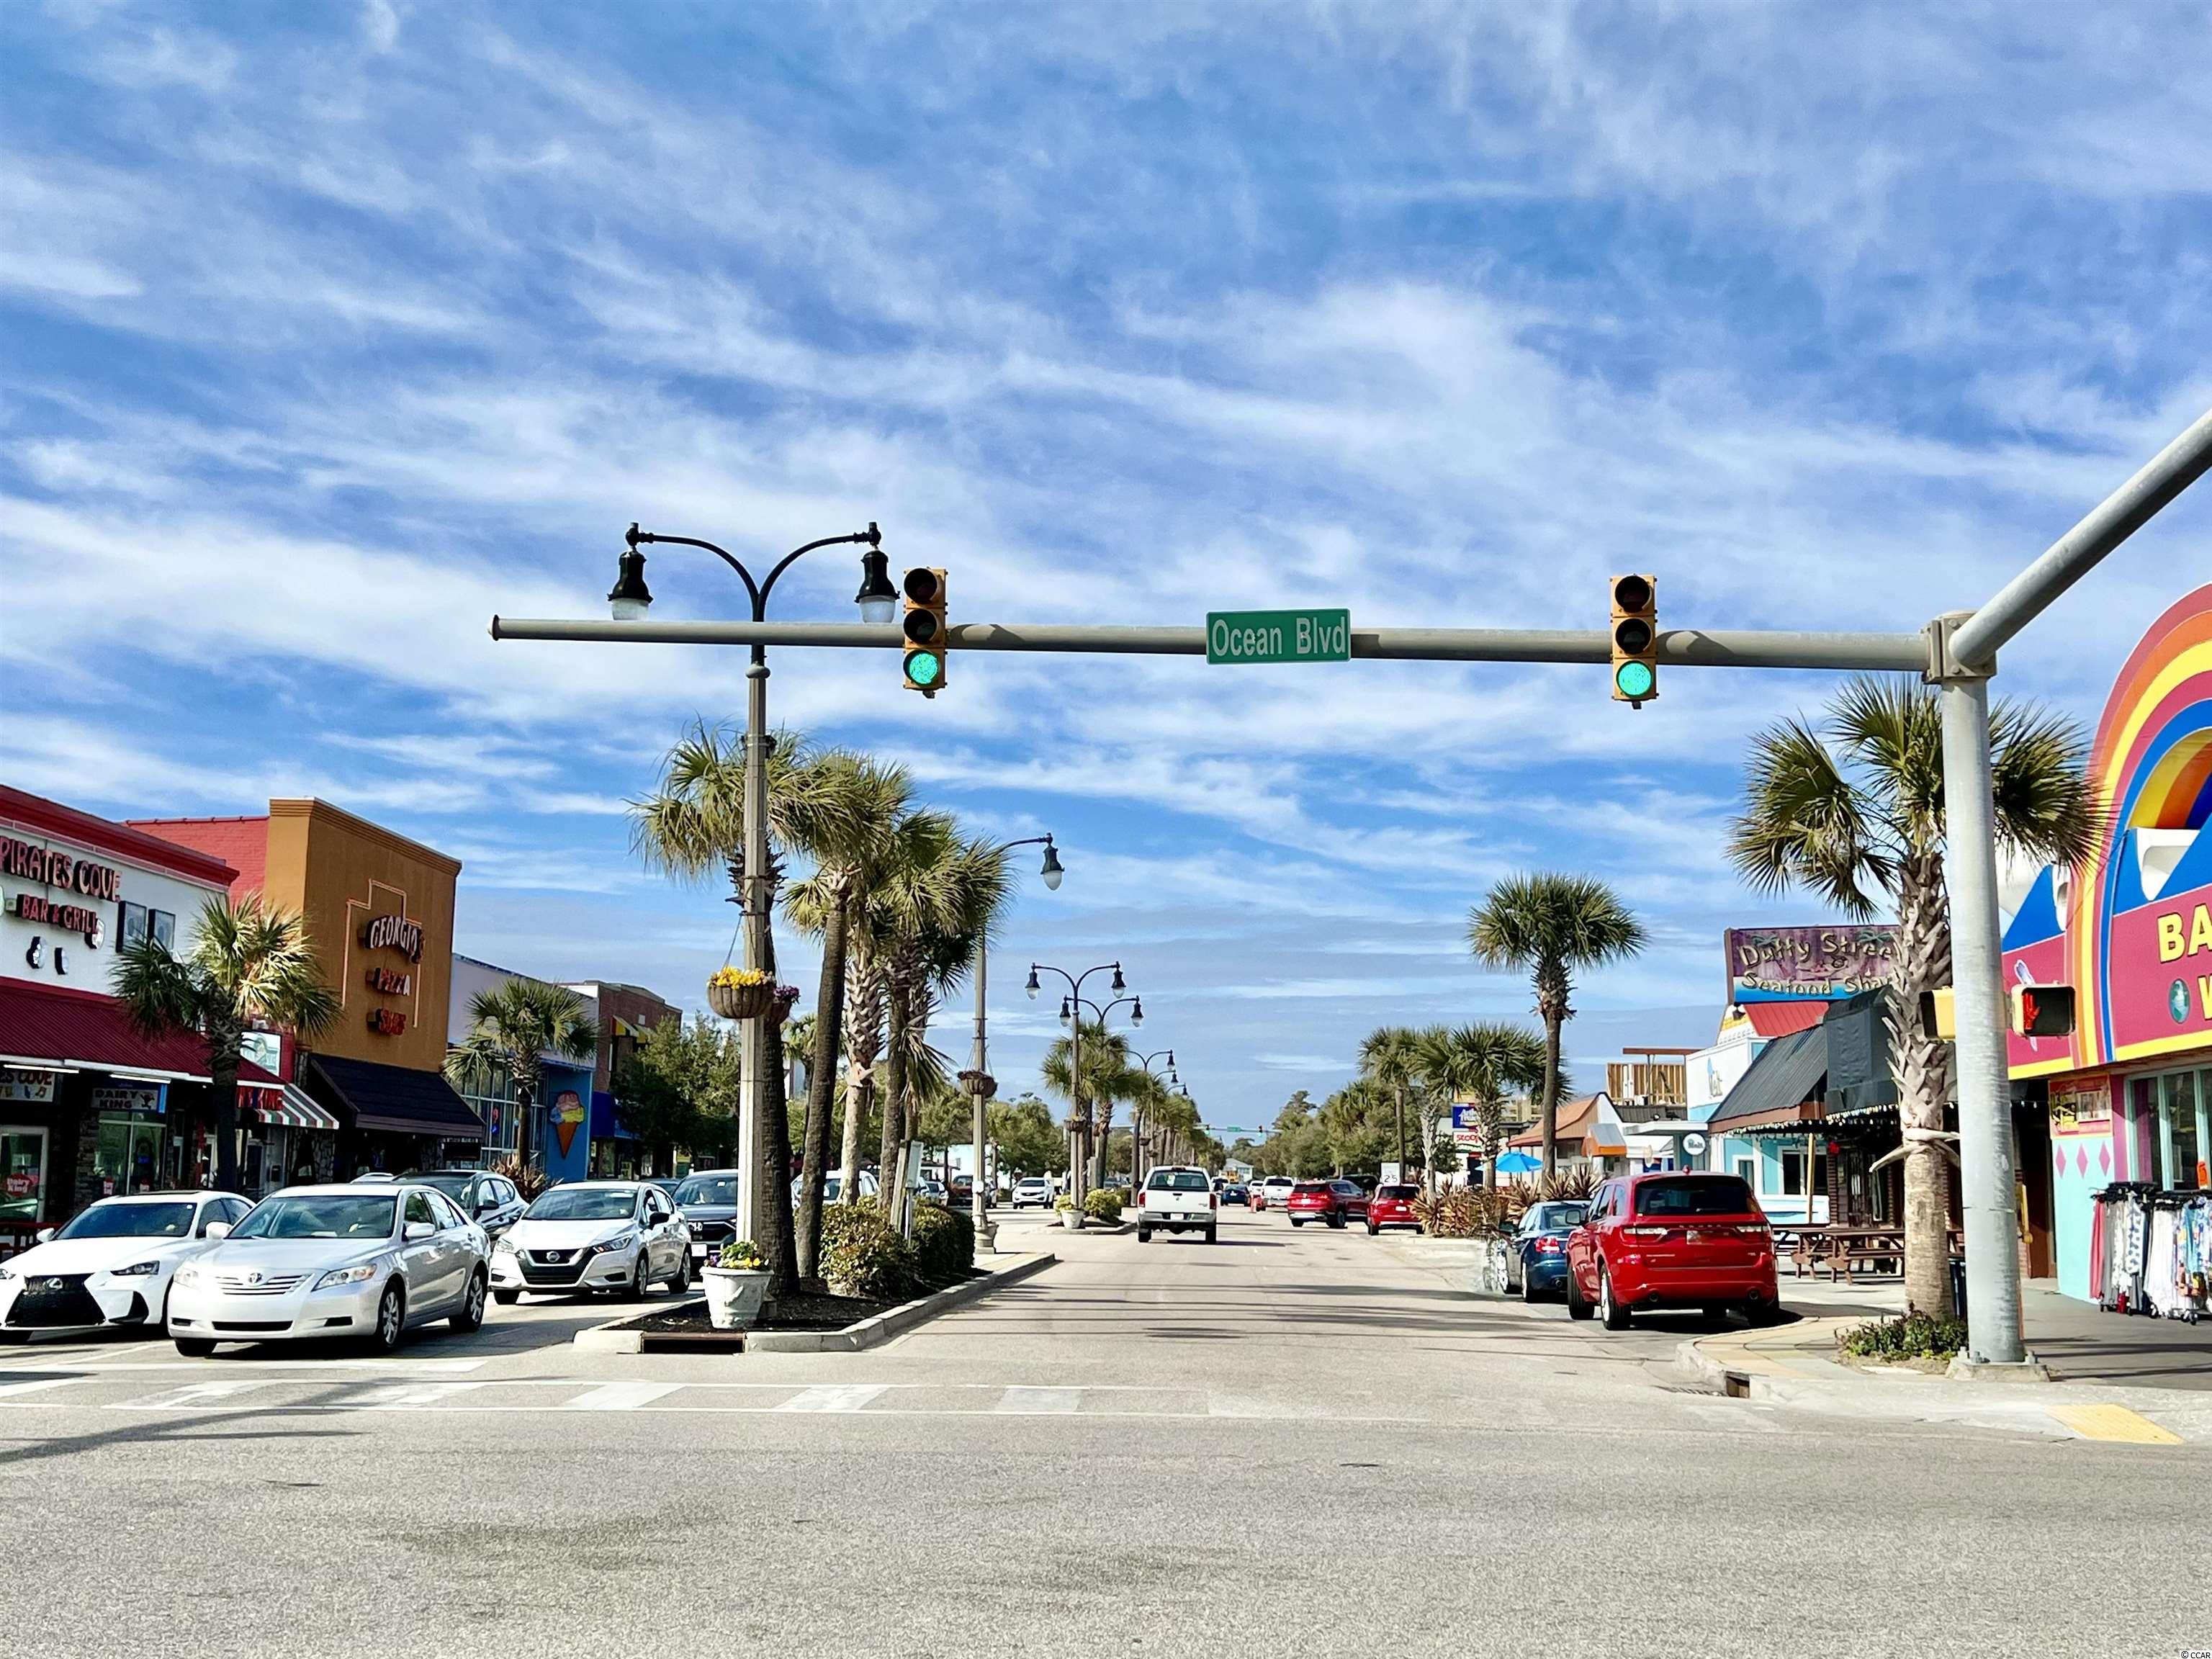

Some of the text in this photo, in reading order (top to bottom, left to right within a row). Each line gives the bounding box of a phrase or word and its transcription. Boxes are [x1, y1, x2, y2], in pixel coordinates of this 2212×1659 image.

[1212, 616, 1345, 657] Ocean Blvd
[0, 836, 122, 903] PIRATES COVE
[20, 895, 48, 922] BAR
[63, 904, 98, 934] GRILL
[1740, 932, 1893, 967] Duffy Stree
[1742, 971, 1831, 996] Seafood
[94, 1089, 138, 1099] DAIRY
[99, 1100, 132, 1109] KING
[1384, 1174, 1398, 1183] 25
